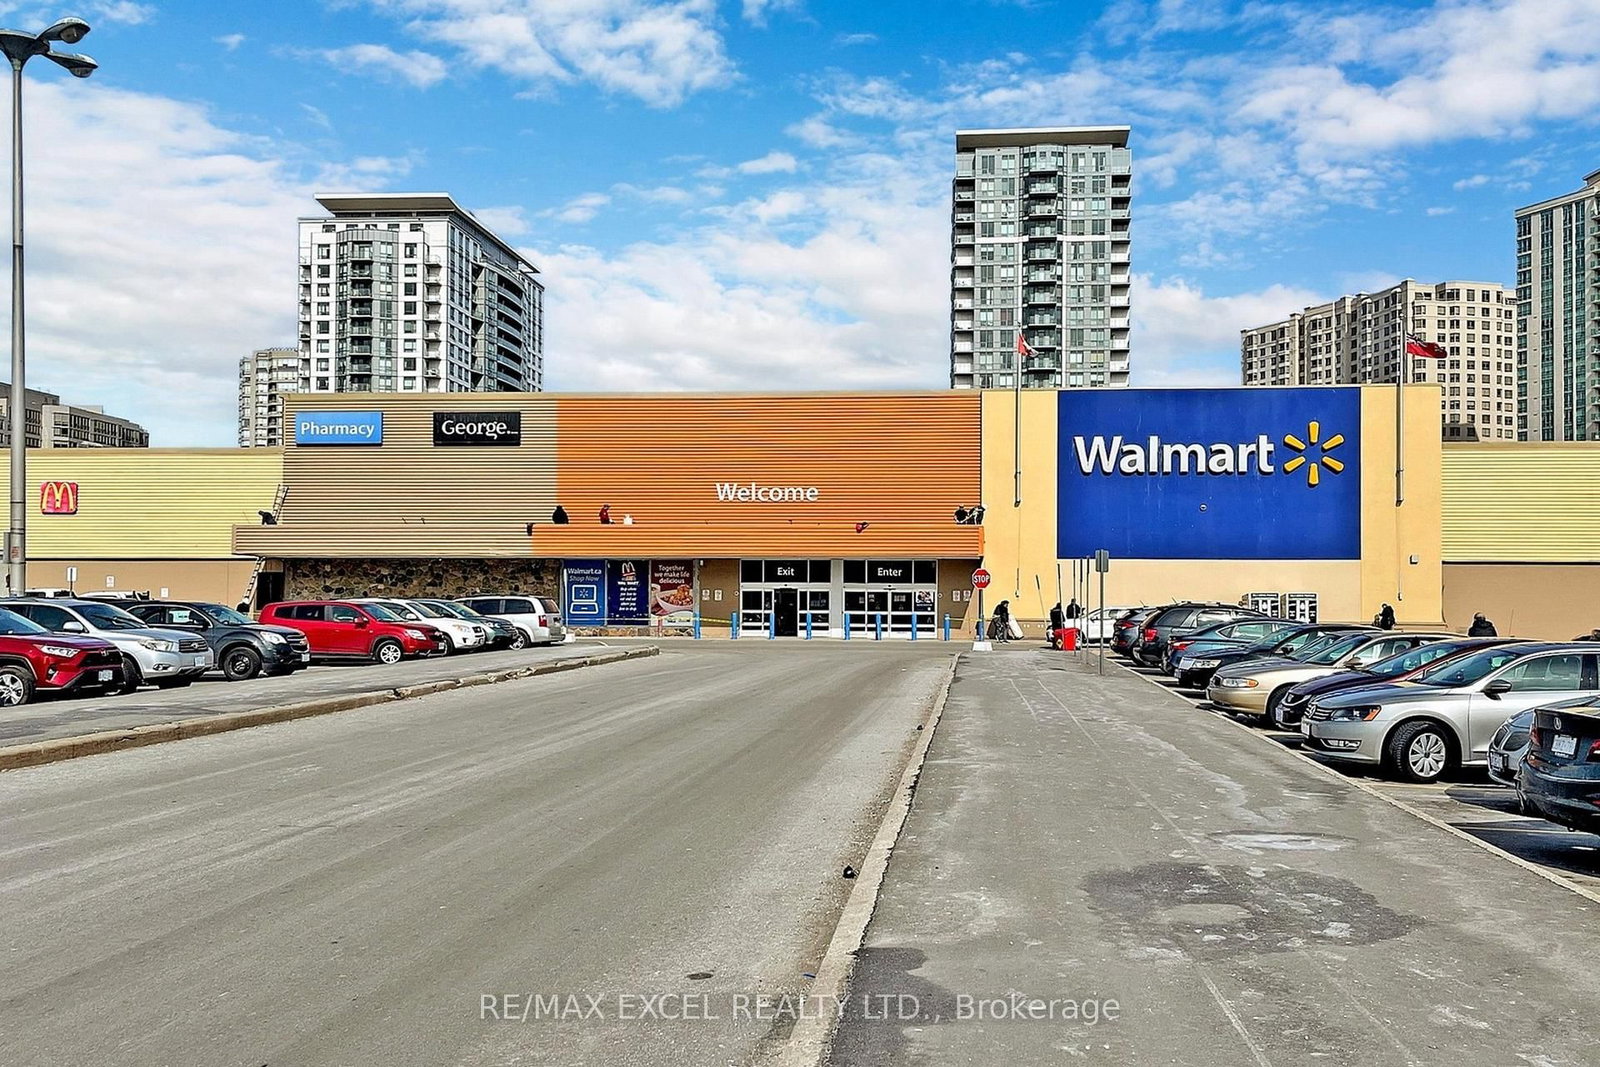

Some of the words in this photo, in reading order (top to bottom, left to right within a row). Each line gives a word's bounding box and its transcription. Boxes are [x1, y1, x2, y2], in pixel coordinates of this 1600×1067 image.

[301, 422, 375, 439] Pharmacy
[1073, 434, 1275, 475] Walmart
[715, 482, 819, 502] Welcome
[658, 564, 685, 572] Together
[777, 567, 795, 577] Exit
[877, 567, 903, 577] Enter
[569, 575, 585, 583] Shop
[974, 574, 990, 583] STOP
